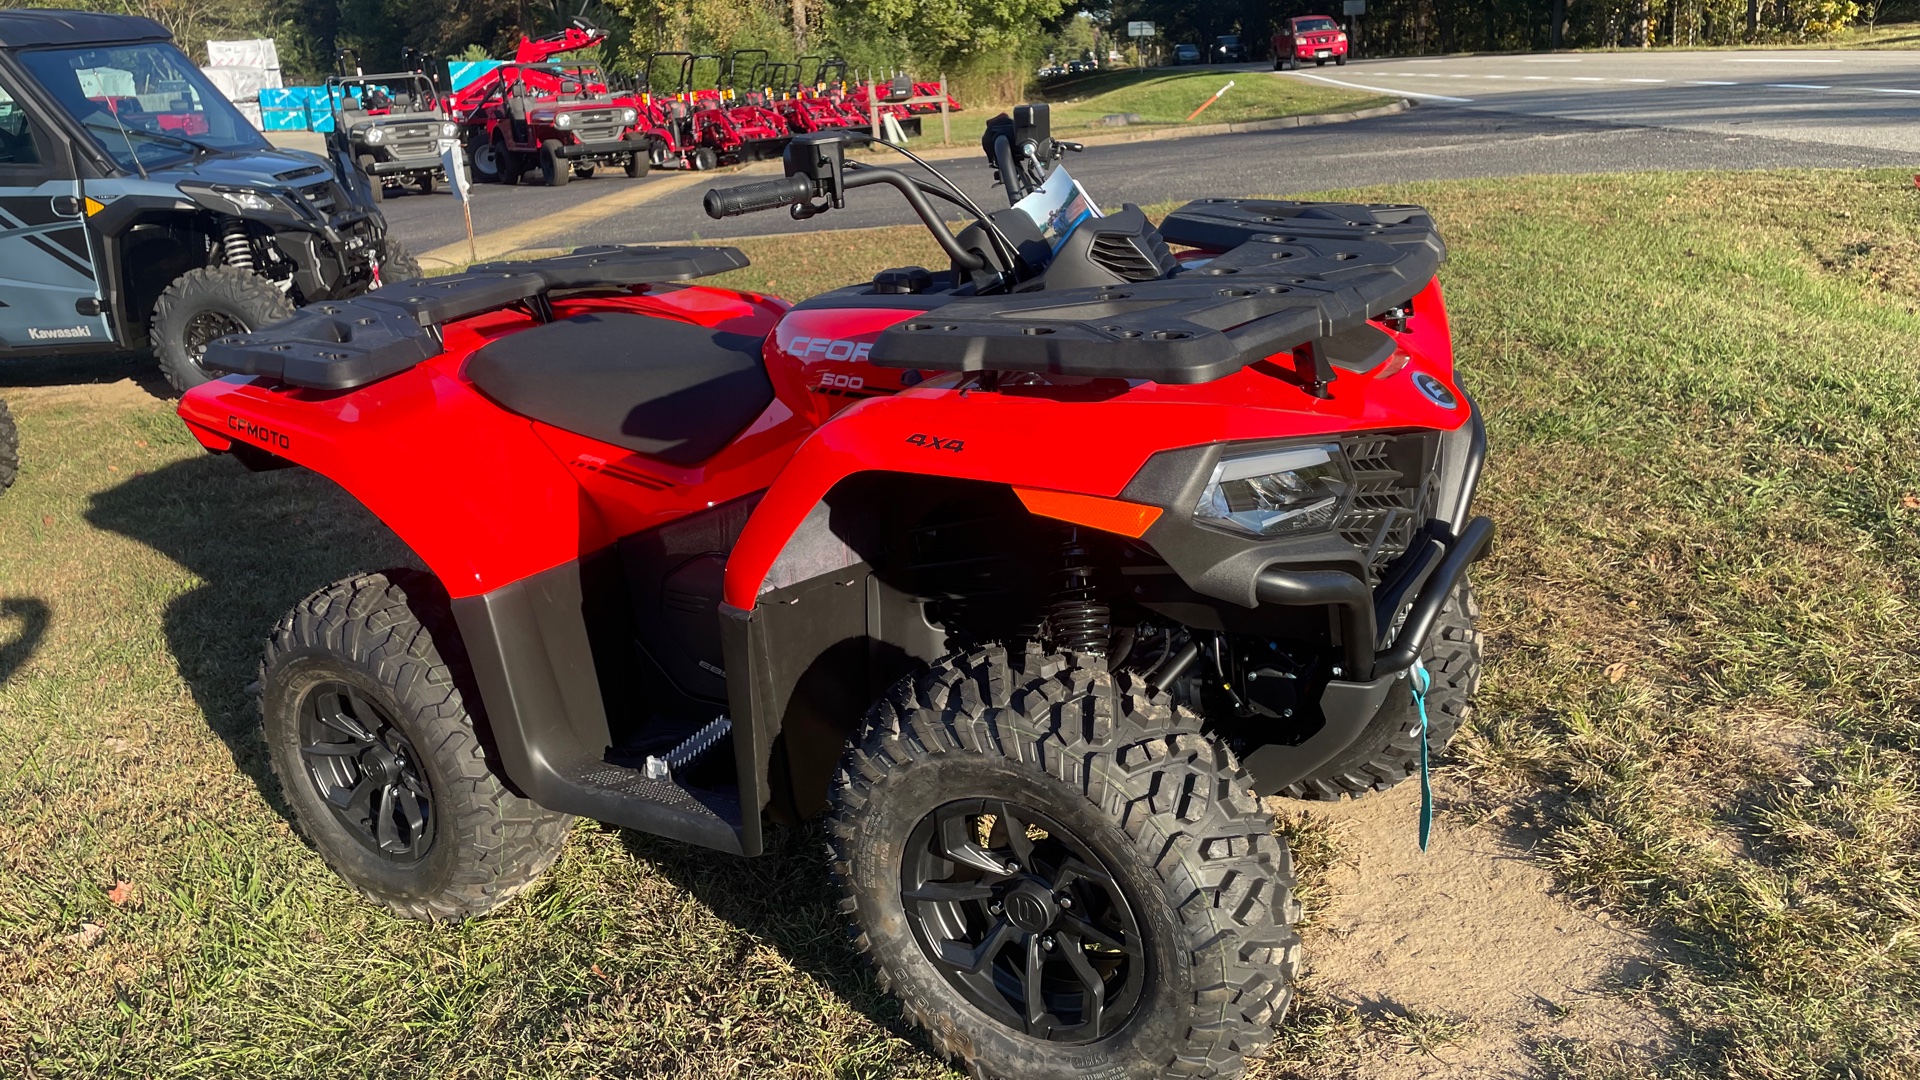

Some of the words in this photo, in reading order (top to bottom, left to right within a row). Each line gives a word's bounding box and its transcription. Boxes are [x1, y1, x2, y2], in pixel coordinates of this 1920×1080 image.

[28, 325, 91, 340] Kawasaki
[821, 372, 864, 389] 500
[228, 415, 290, 449] CFMOTO
